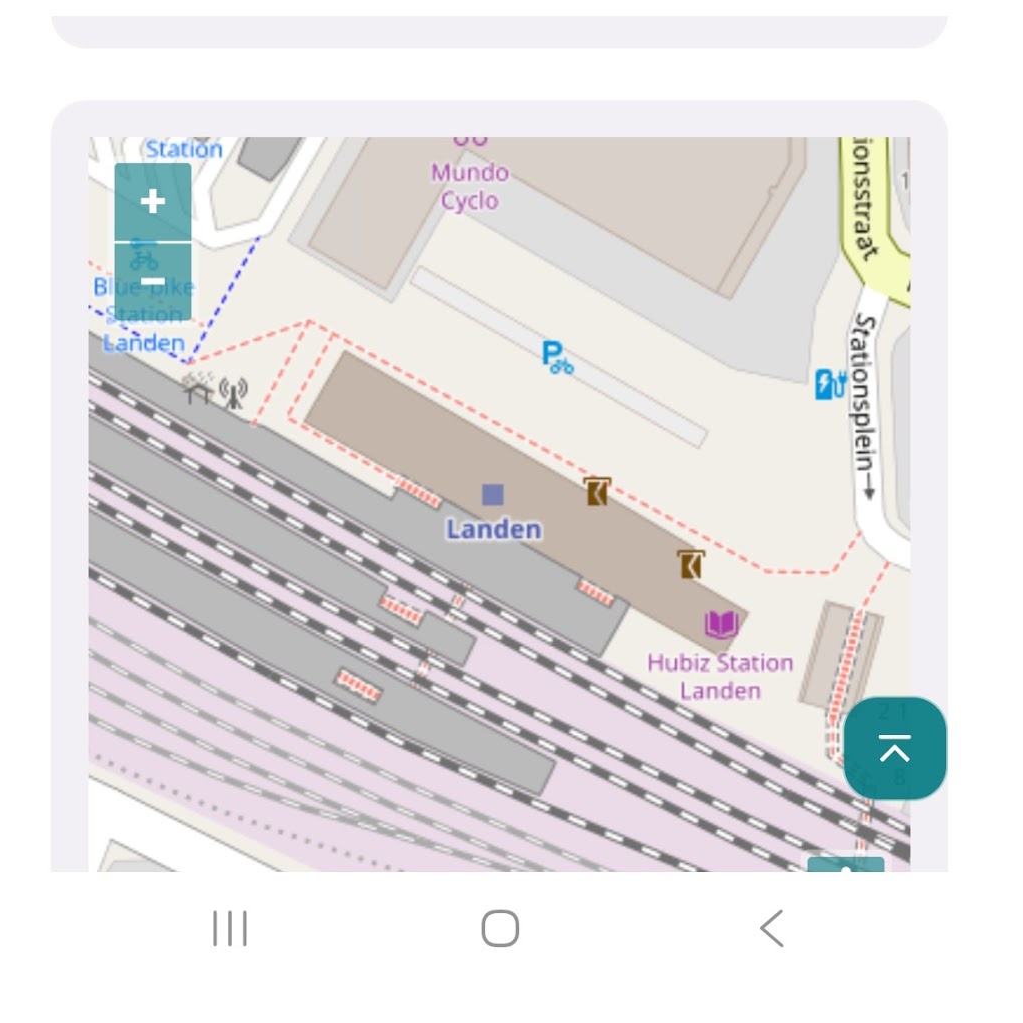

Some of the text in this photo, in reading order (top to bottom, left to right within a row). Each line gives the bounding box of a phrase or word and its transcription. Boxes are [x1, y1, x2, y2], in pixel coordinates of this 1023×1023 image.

[146, 138, 223, 158] Station
[432, 162, 509, 182] Mundo
[442, 190, 499, 214] Cyclo
[106, 305, 183, 324] Station
[103, 333, 186, 353] Landen
[543, 340, 563, 365] P
[848, 312, 877, 472] Stationsplein
[448, 517, 542, 539] Landen
[647, 652, 794, 672] Hubiz Station
[681, 681, 761, 700] Landen
